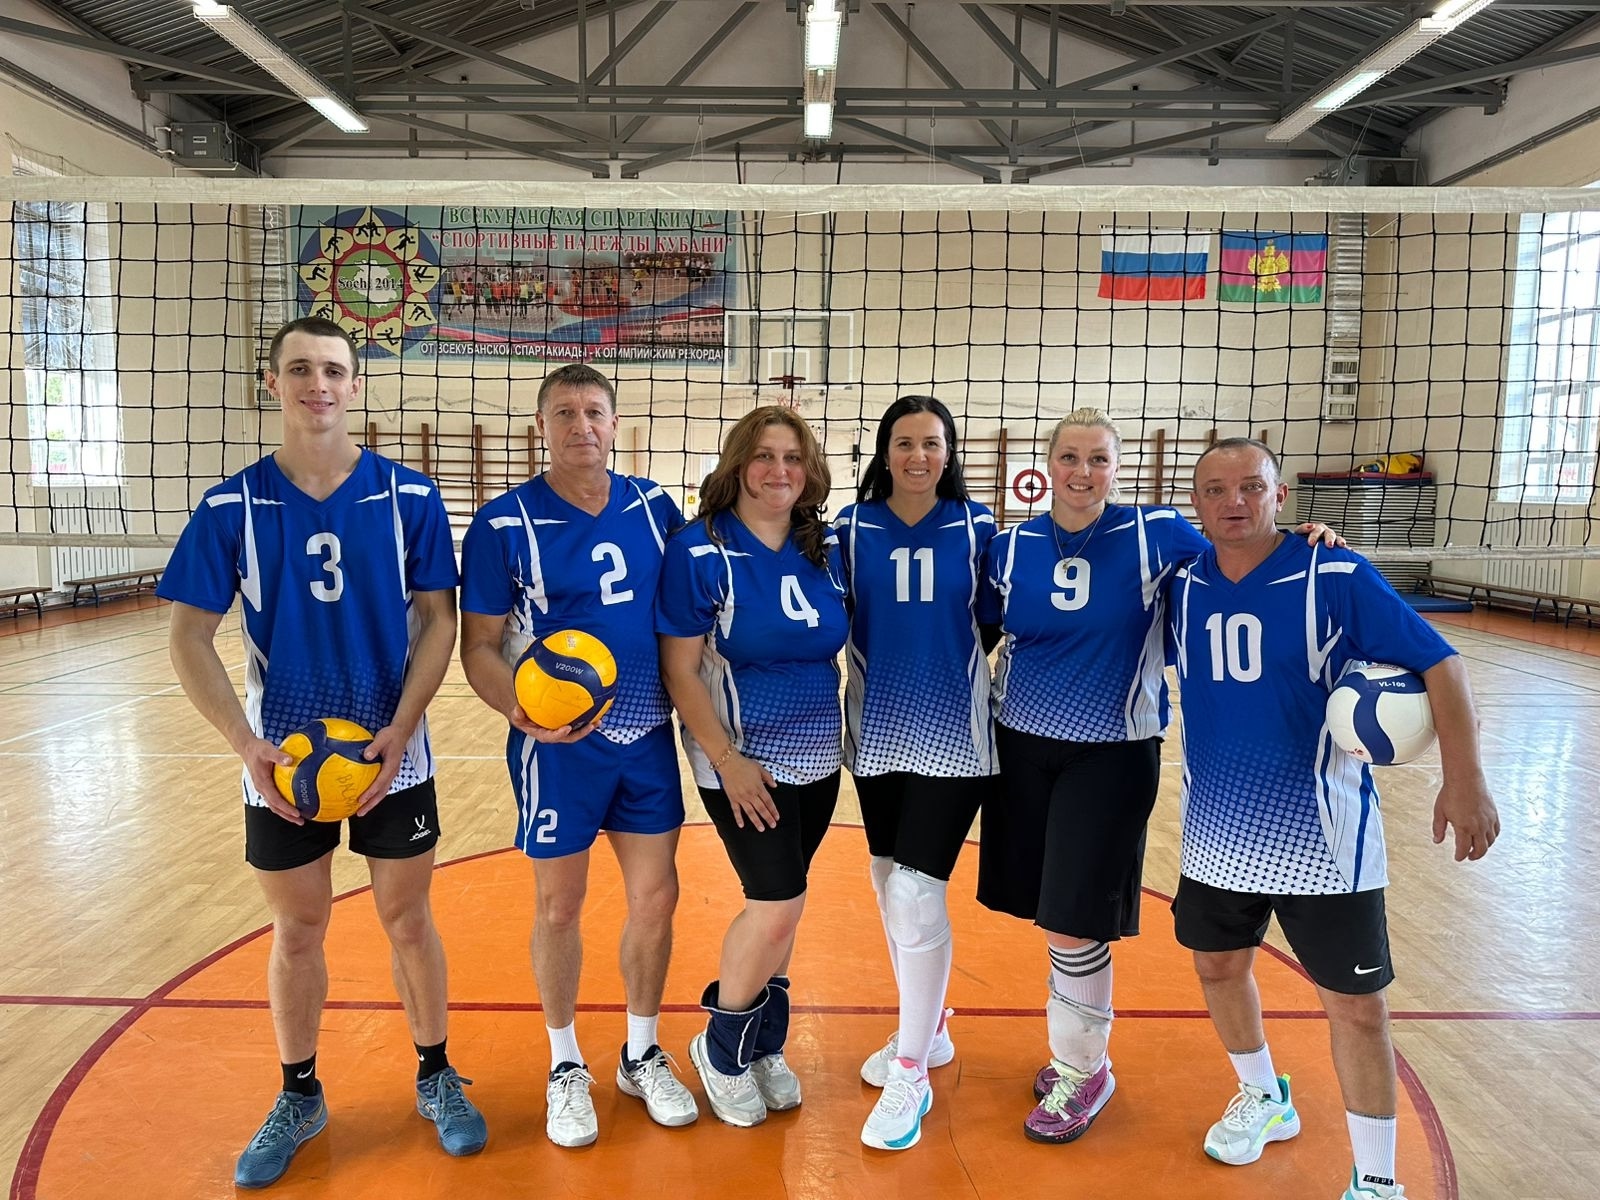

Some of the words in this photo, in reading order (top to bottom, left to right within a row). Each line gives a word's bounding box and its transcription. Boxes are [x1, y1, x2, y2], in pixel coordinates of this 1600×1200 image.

[449, 206, 585, 226] ВСЕКУБАНСКАЯ
[564, 234, 650, 254] НАДЕЖДЫ
[338, 277, 371, 290] Soch
[375, 277, 404, 290] 2014
[420, 342, 434, 354] ОТ
[515, 344, 587, 359] СПАРТАКИАДЫ
[595, 346, 601, 358] К
[306, 532, 344, 603] 3
[591, 542, 634, 606] 2
[889, 547, 934, 602] 11
[1050, 557, 1090, 611] 9
[780, 575, 820, 628] 4
[555, 662, 584, 675] V200W
[1205, 612, 1263, 683] 10
[536, 808, 558, 843] 2
